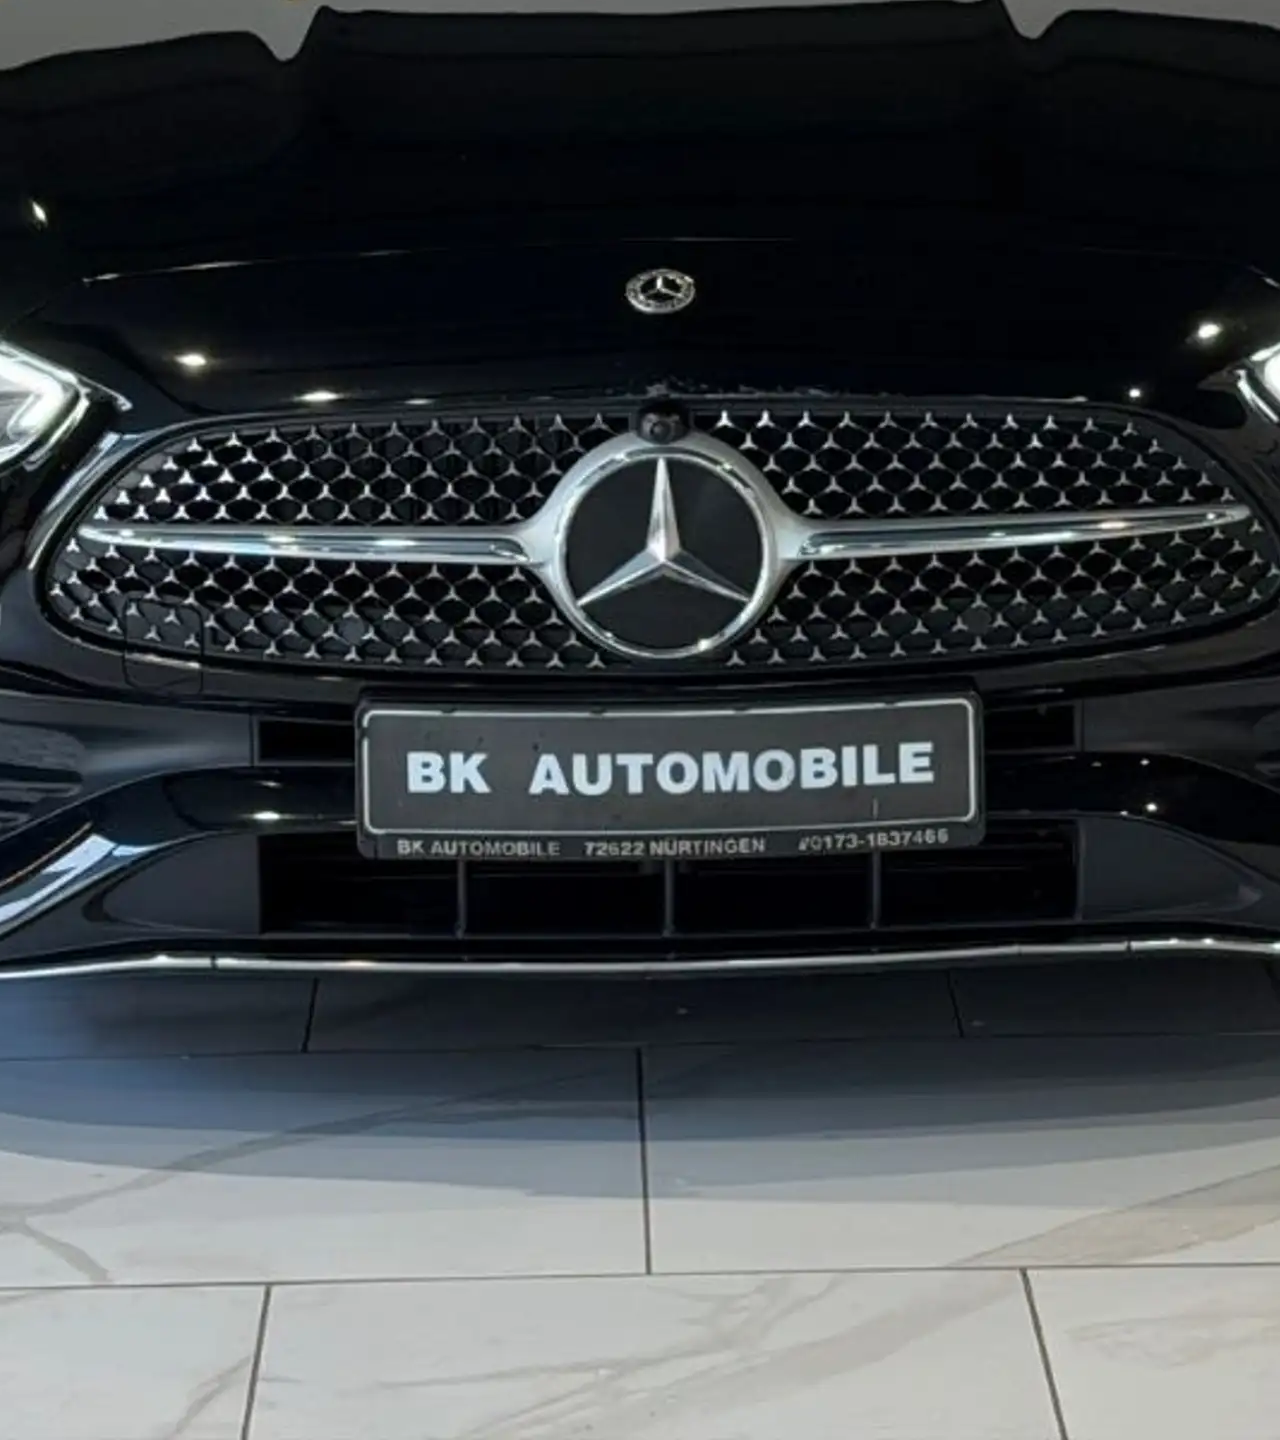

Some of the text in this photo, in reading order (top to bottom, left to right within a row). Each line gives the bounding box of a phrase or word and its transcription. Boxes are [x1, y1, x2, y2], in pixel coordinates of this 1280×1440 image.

[406, 741, 936, 796] BK AUTOMOBILE
[396, 839, 424, 856] BK
[430, 840, 561, 857] AUTOMOBILE
[583, 840, 645, 857] 72622
[649, 837, 766, 857] NÜRTINGEN
